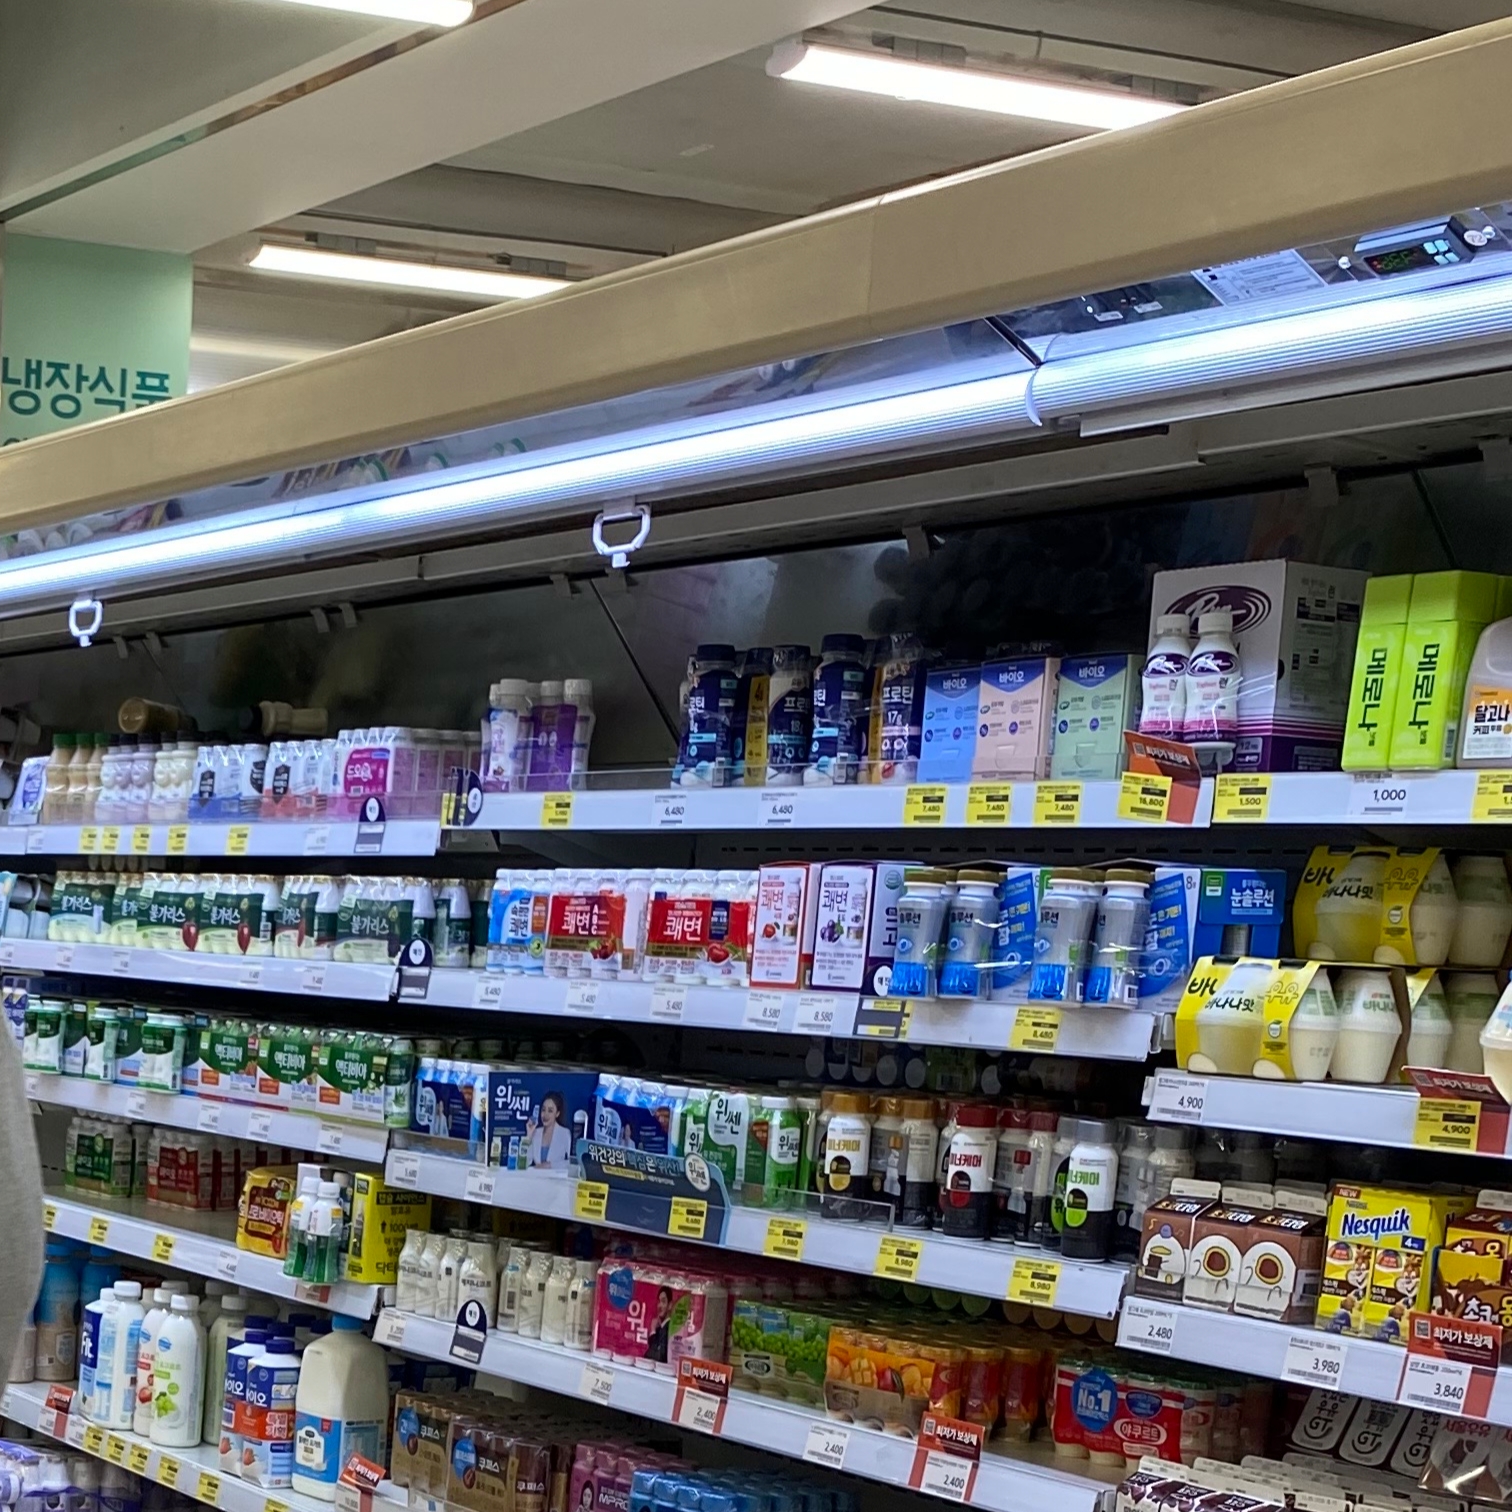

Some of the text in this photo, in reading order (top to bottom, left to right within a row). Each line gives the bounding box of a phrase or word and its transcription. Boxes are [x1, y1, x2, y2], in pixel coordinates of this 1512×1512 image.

[998, 671, 1025, 684] 바이오
[1078, 665, 1106, 679] 바이오
[942, 678, 968, 691] 바이오
[1357, 647, 1388, 732] 메로나
[1407, 642, 1441, 731] 메로나
[882, 686, 915, 705] 프로틴
[1474, 703, 1511, 723] 달고나
[1472, 724, 1490, 735] 커피
[1239, 796, 1262, 807] 1,500
[1373, 788, 1407, 803] 1,000
[771, 804, 794, 816] 6,480
[761, 889, 785, 913] 쾌변
[821, 889, 849, 913] 쾌변
[1230, 887, 1275, 908] 눈솔루션
[149, 903, 187, 924] 불가리스
[210, 905, 241, 926] 불가리스
[350, 914, 390, 937] 불가리스
[561, 911, 591, 937] 쾌변
[663, 916, 703, 941] 쾌변
[665, 1000, 684, 1012] 5,480
[761, 1007, 782, 1020] 8,580
[813, 1010, 834, 1023] 8,580
[273, 1053, 307, 1072] 액티비아
[335, 1058, 368, 1080] 액티비아
[494, 1084, 531, 1121] 위쎈
[1178, 1094, 1204, 1110] 4,900
[715, 1097, 743, 1135] 위쎈
[1441, 1124, 1471, 1135] 4,900
[589, 1143, 627, 1168] 위건강의
[1338, 1188, 1358, 1198] NEW
[1341, 1208, 1410, 1241] Nesquik
[893, 1257, 914, 1268] 8,980
[1029, 1280, 1051, 1291] 8,980
[626, 1300, 649, 1346] 윌
[1147, 1324, 1173, 1340] 2,480
[1433, 1326, 1494, 1350] 최저가 보상제
[1312, 1357, 1341, 1375] 3,980
[593, 1378, 613, 1392] 7,500
[1433, 1382, 1465, 1401] 3,840
[1077, 1387, 1113, 1414] No.1
[265, 1412, 289, 1427] 특별
[696, 1407, 717, 1421] 2,400
[265, 1424, 289, 1441] 기획
[1121, 1421, 1160, 1441] 야쿠르트
[1308, 1416, 1334, 1432] GT
[1441, 1418, 1492, 1437] 서울우유
[935, 1423, 978, 1447] 최저가 보상제
[1357, 1430, 1383, 1448] GT
[824, 1441, 844, 1456] 2,400
[943, 1474, 965, 1490] 2,400
